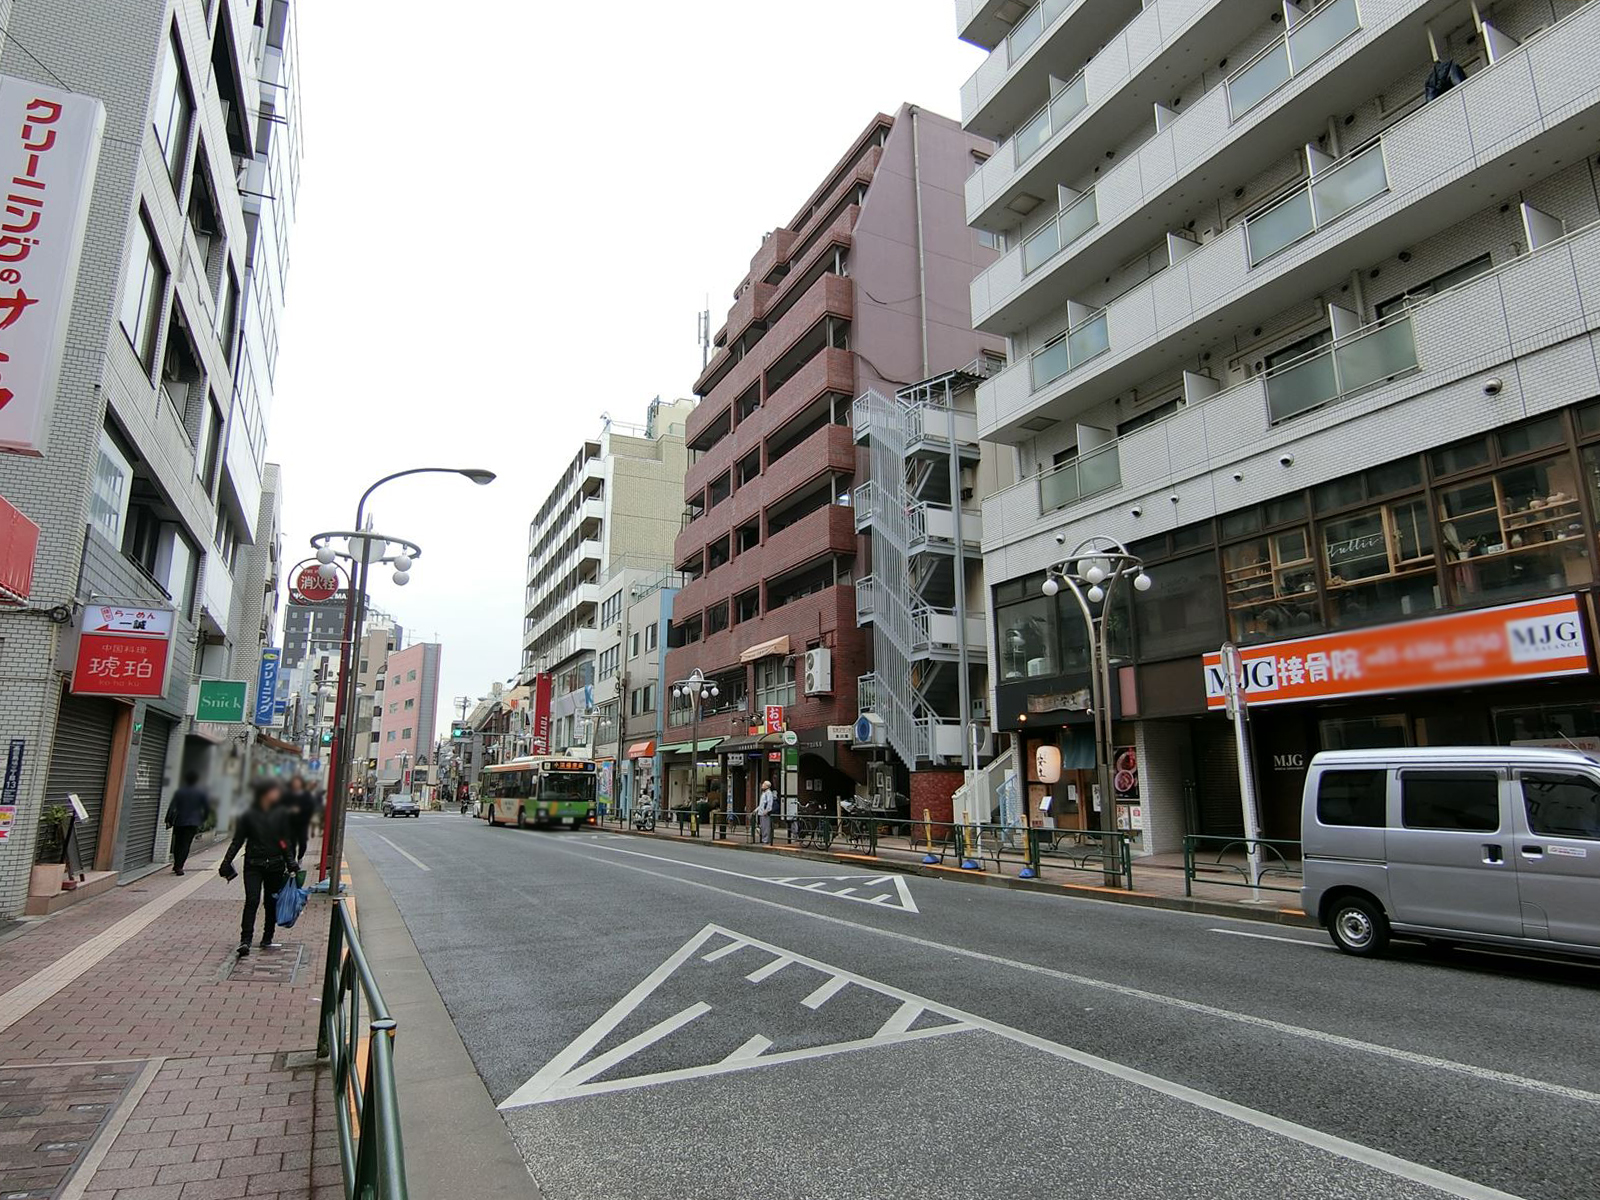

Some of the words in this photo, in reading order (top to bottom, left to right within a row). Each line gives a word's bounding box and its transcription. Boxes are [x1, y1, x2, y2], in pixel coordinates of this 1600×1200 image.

[301, 575, 336, 590] 消火栓
[115, 610, 156, 620] らーめん
[1511, 621, 1578, 646] MJG
[102, 644, 148, 654] 中国料理
[88, 656, 153, 678] 琥珀
[260, 663, 275, 713] クリーニング
[201, 696, 241, 709] Snick
[1273, 754, 1304, 767] MJG
